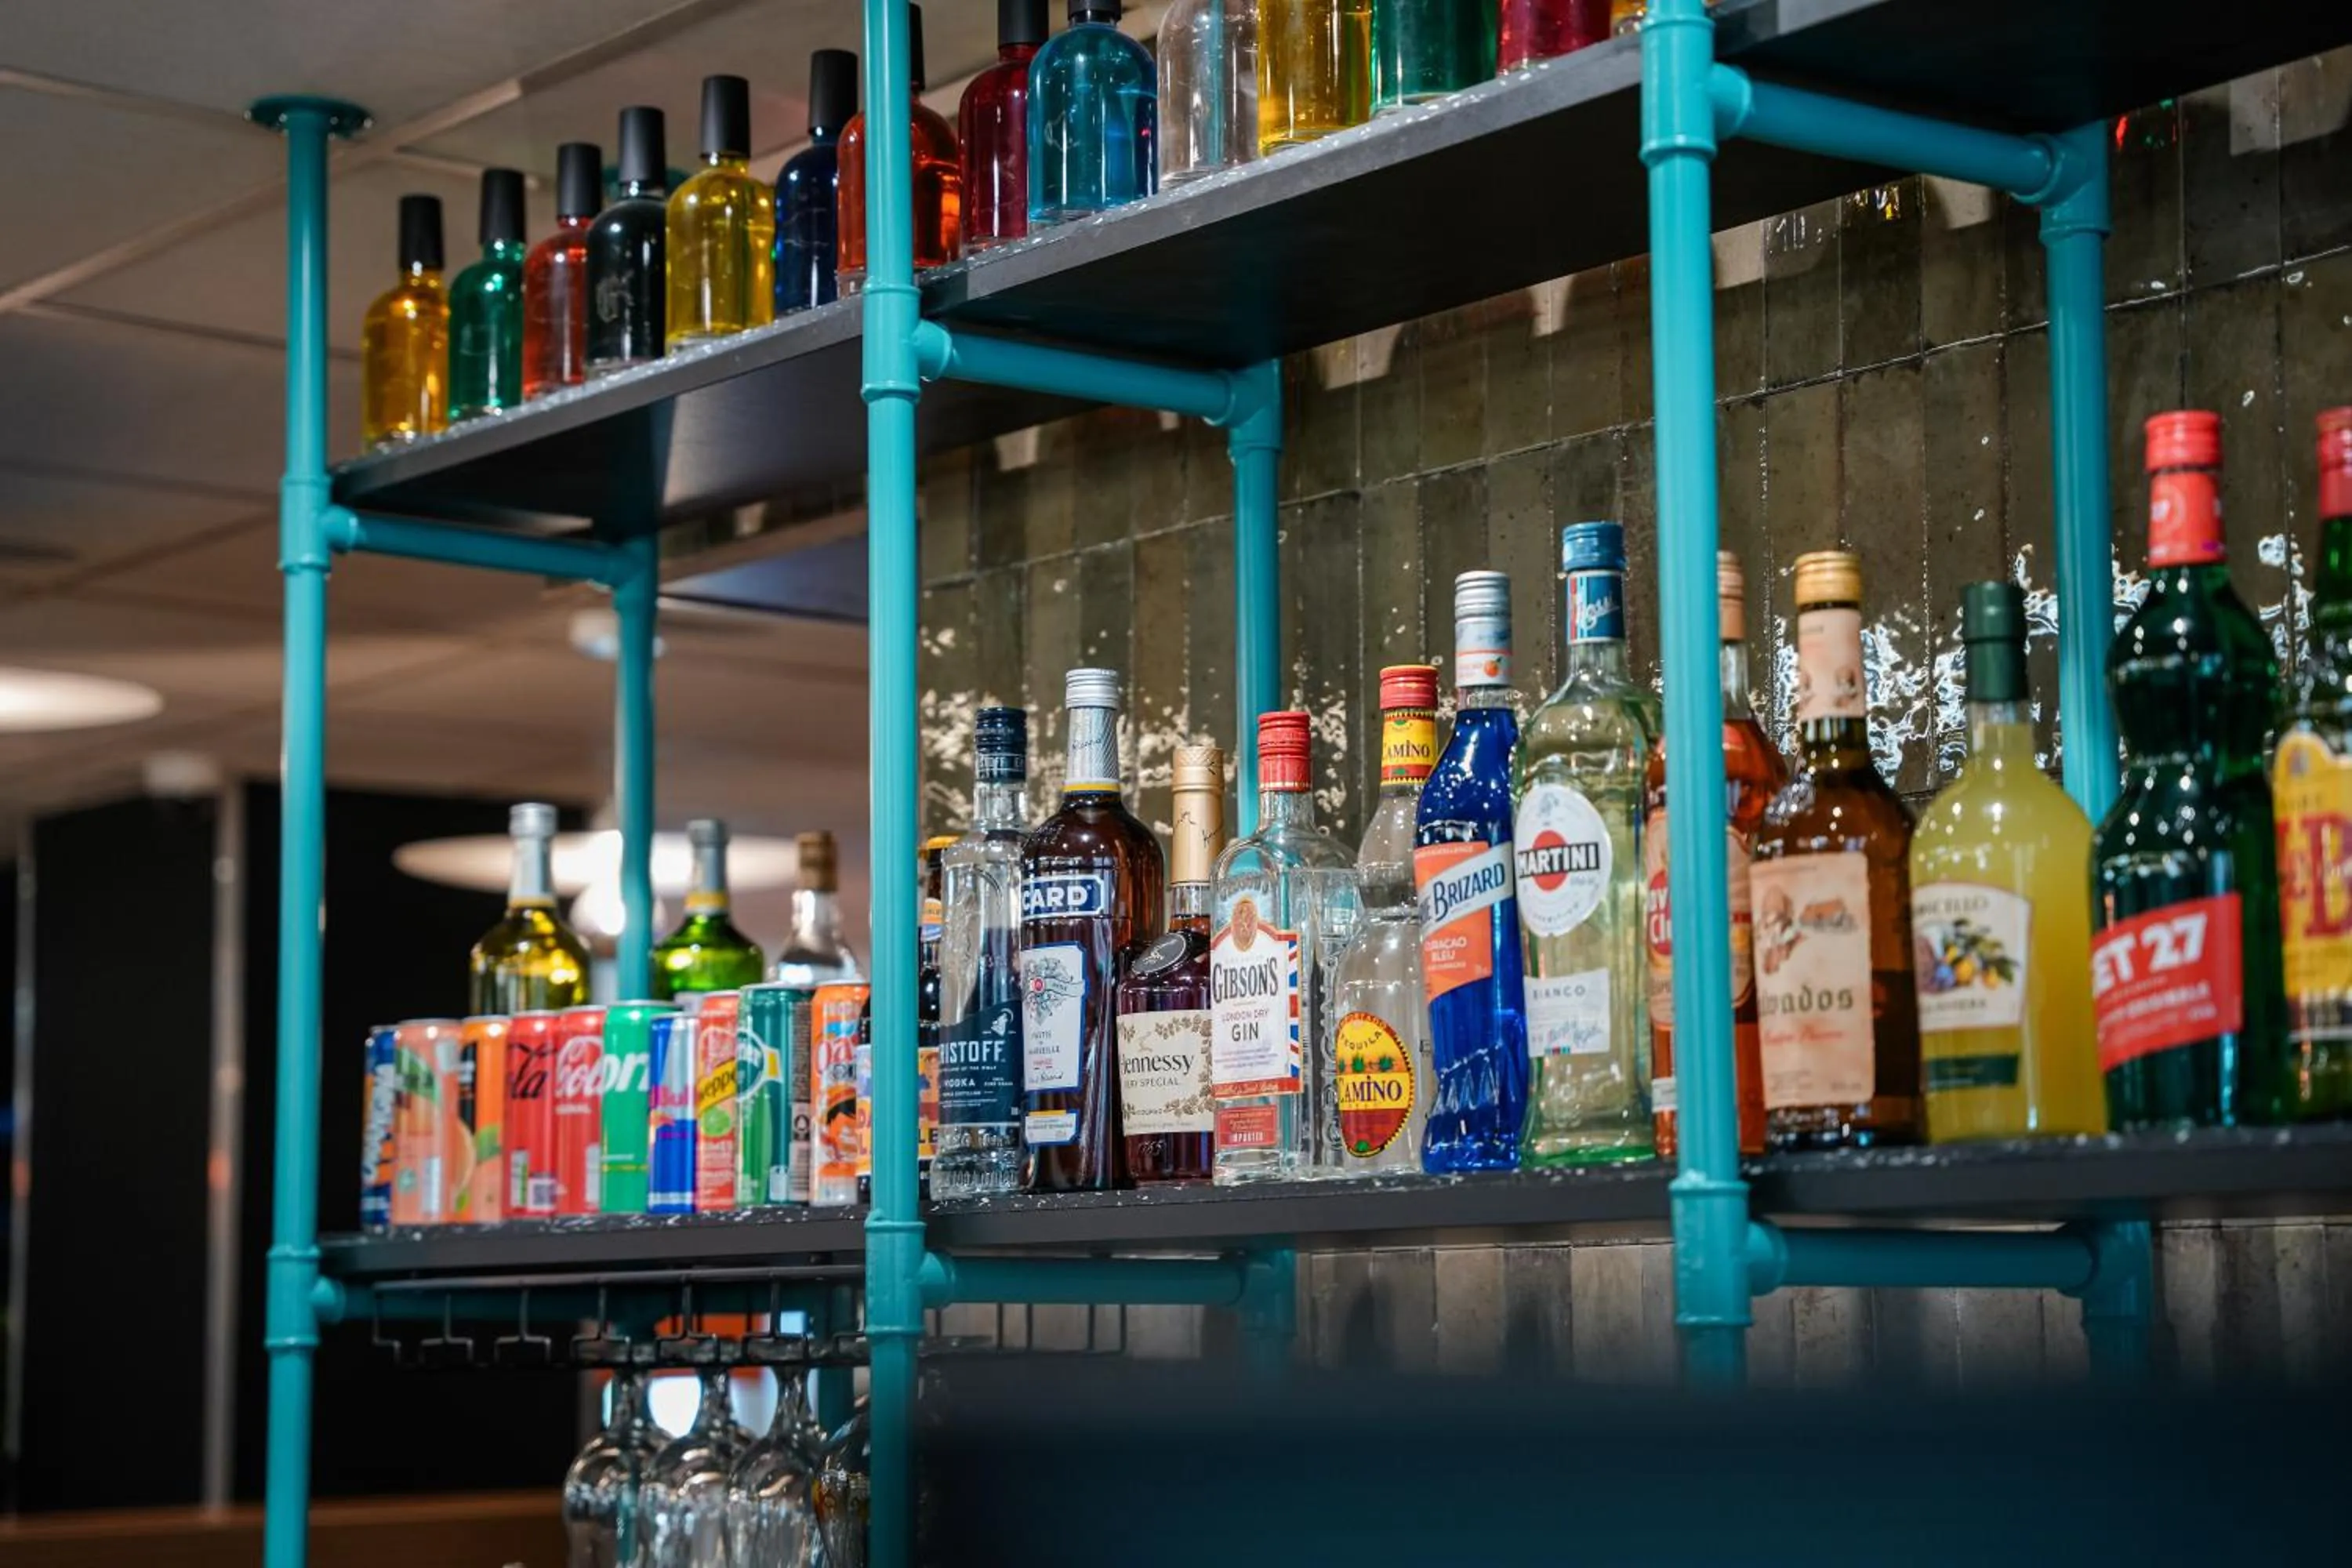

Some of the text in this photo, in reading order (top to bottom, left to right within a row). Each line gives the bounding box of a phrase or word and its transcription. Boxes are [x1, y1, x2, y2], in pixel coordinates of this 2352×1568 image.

[1518, 844, 1597, 876] MARTINI
[1022, 885, 1088, 910] CARD
[1433, 862, 1506, 922] BRIZARD
[2092, 932, 2136, 999] ET
[2140, 911, 2207, 973] 27
[1213, 956, 1279, 1004] GIBSON'S
[1232, 1022, 1258, 1041] GIN
[1340, 1031, 1382, 1051] TEQUILA
[939, 1040, 1005, 1063] ISTOFF
[945, 1078, 977, 1087] VODKA
[1140, 1076, 1179, 1087] SPECIAL
